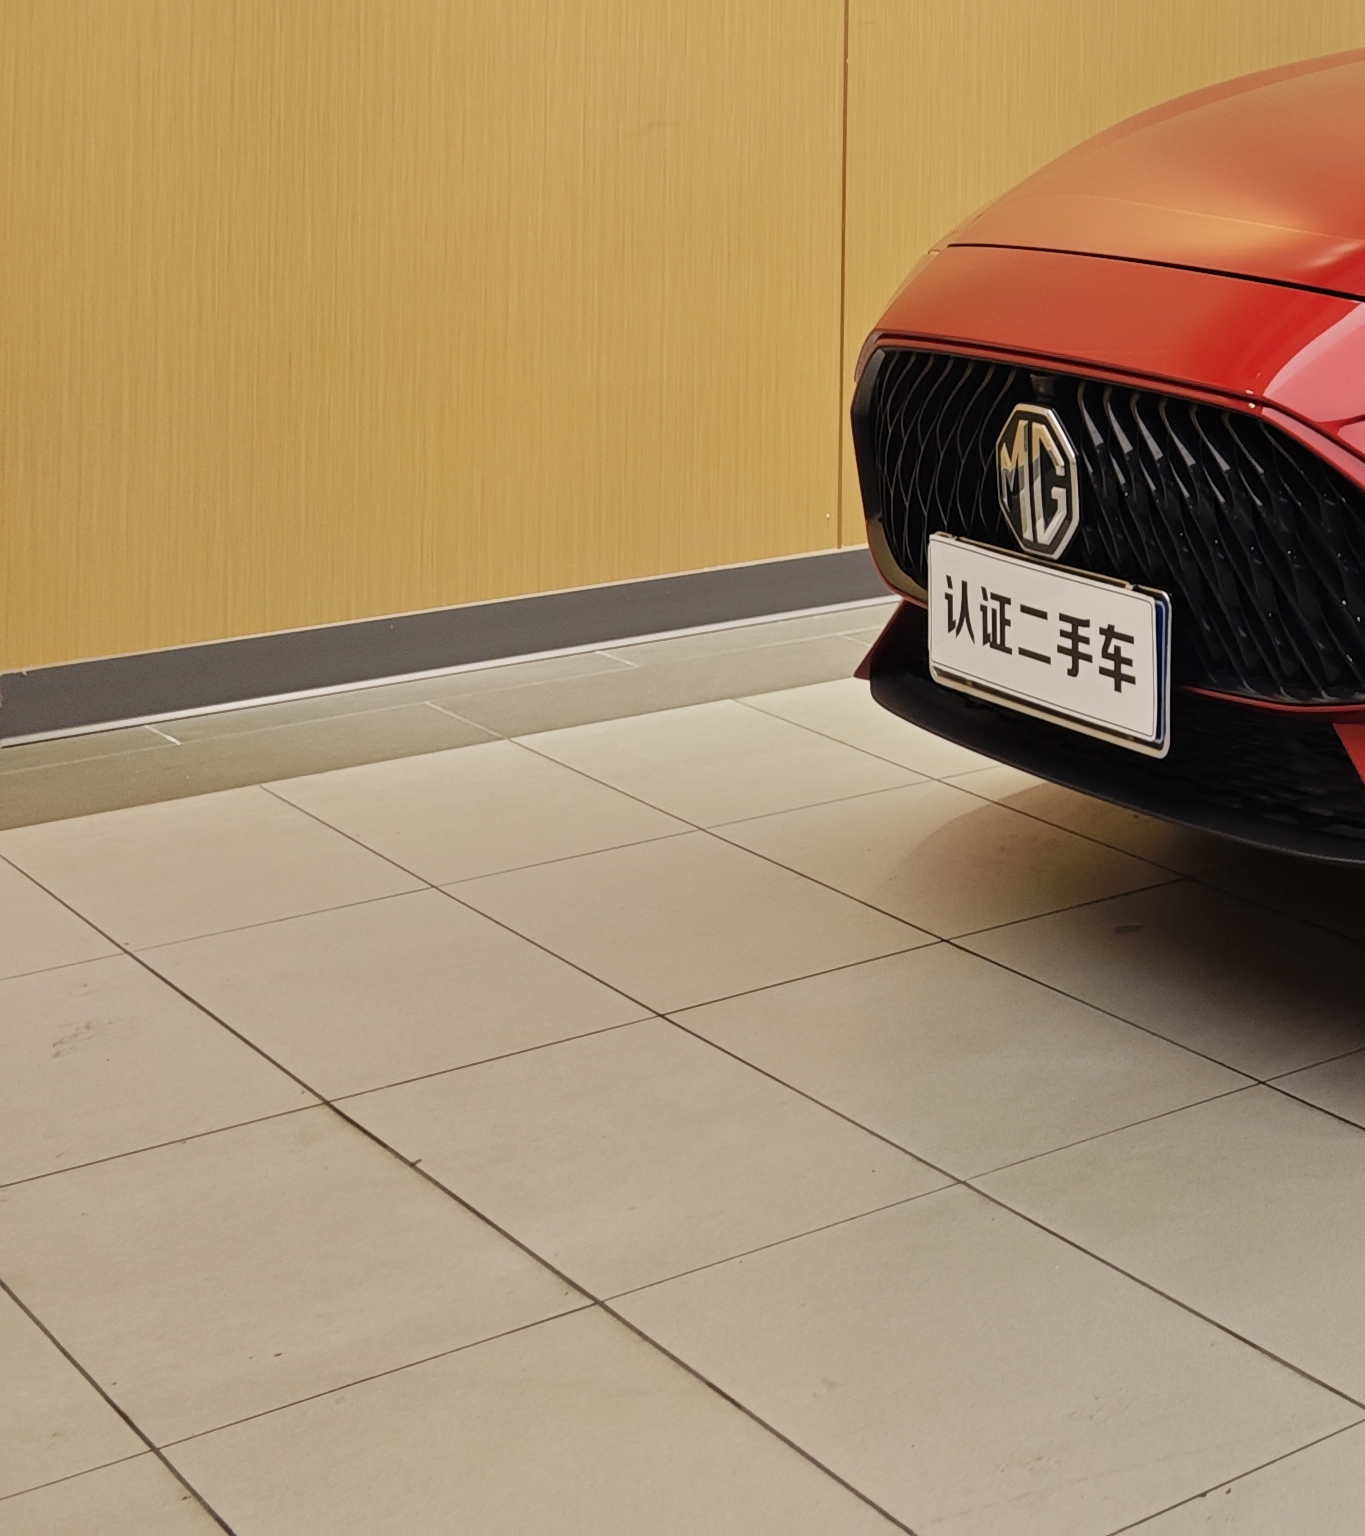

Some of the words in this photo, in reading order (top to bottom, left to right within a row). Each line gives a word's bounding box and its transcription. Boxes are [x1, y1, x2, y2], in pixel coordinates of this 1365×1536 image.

[999, 418, 1067, 547] MG
[943, 574, 1137, 694] 认证二手车
